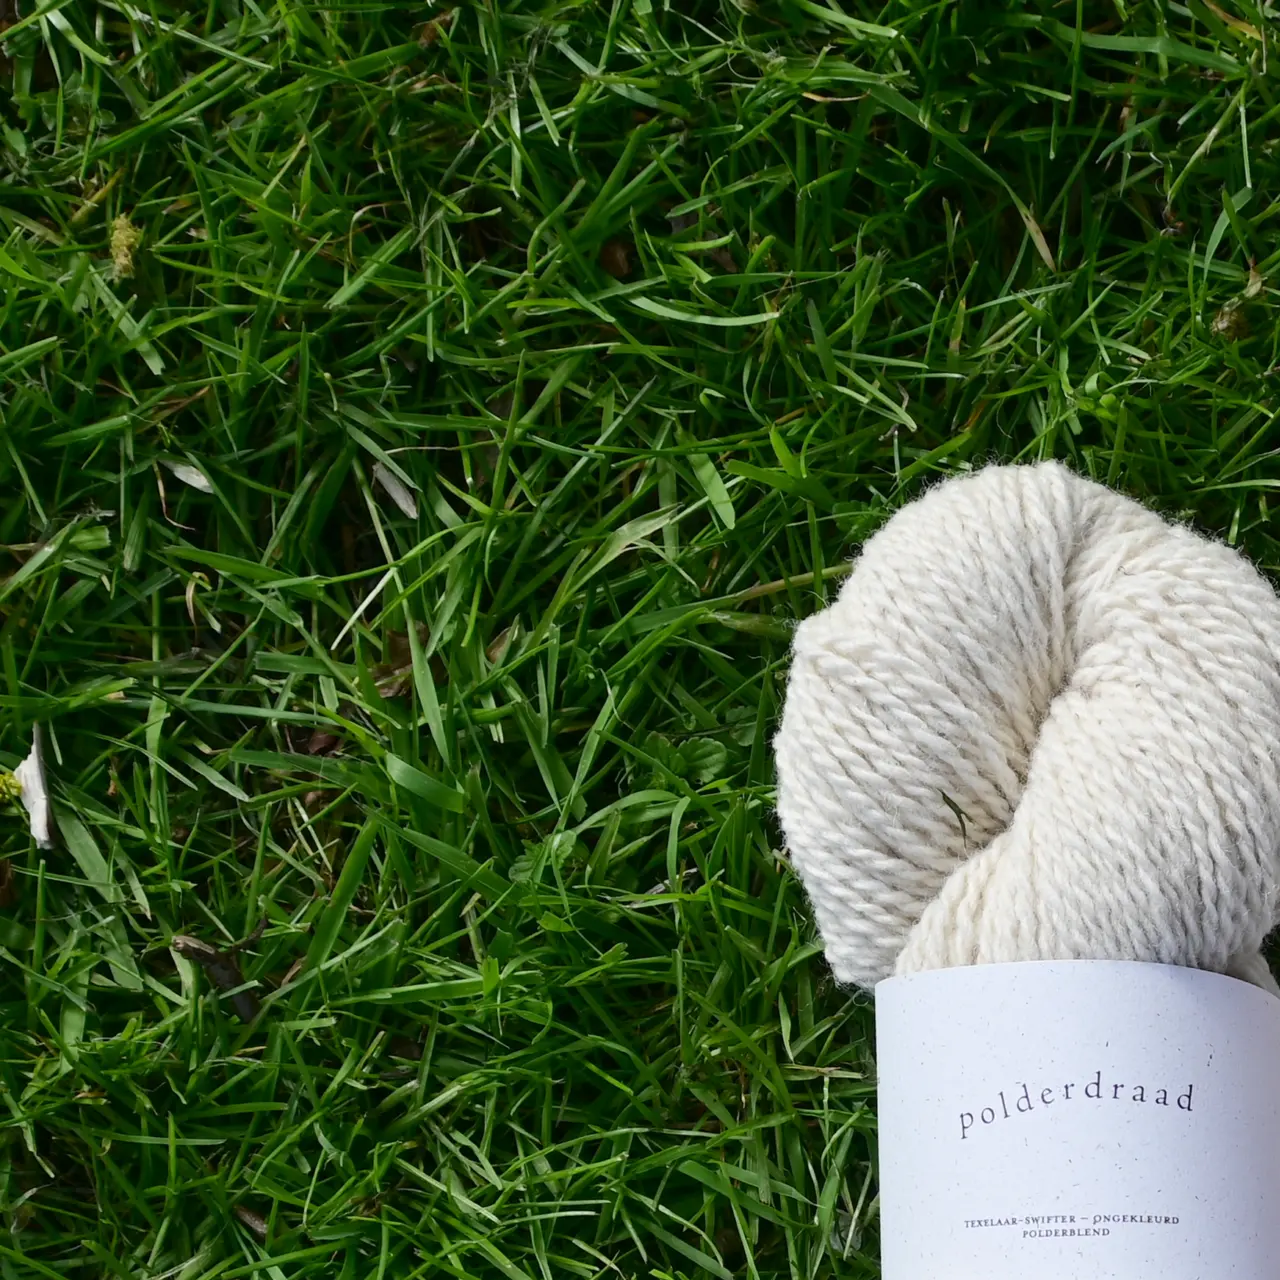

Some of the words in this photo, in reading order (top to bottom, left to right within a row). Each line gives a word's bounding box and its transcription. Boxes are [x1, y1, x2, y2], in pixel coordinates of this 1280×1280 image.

[959, 1070, 1193, 1139] polderdraad
[964, 1214, 1076, 1228] TEXELAAR-SWIFTER
[1092, 1214, 1180, 1225] ONGEKLEURD
[1022, 1228, 1110, 1238] POLDERBLEND
